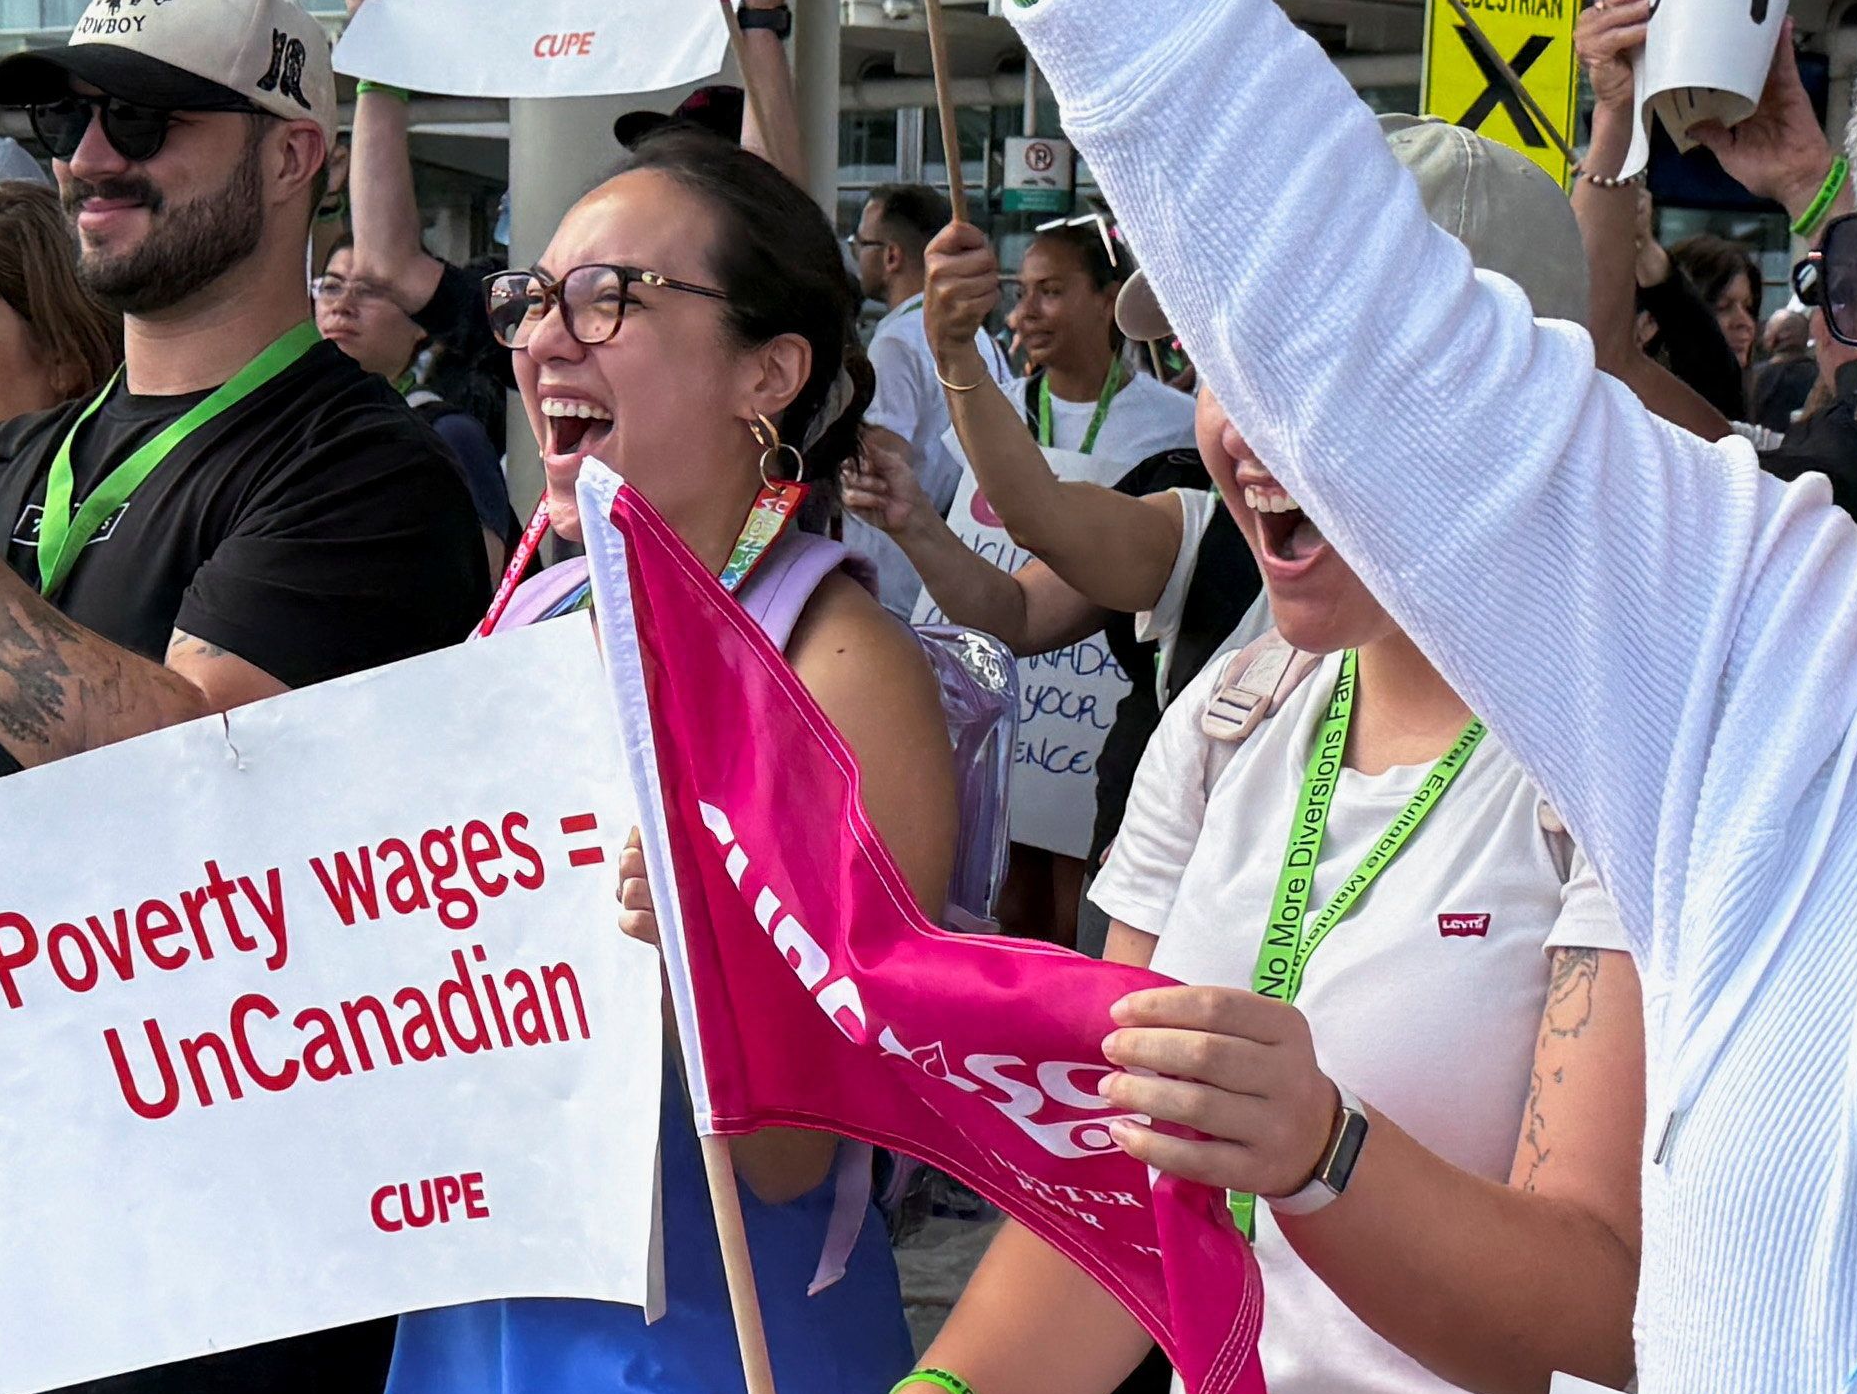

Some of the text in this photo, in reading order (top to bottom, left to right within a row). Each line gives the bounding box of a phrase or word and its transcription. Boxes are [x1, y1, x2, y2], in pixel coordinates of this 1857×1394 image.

[532, 32, 597, 59] CUPE
[1018, 684, 1111, 730] YOUR
[310, 810, 546, 931] wages
[1257, 670, 1353, 1000] No More Diversions Fair
[103, 943, 592, 1121] UnCanadian
[370, 1171, 490, 1233] CUPE
